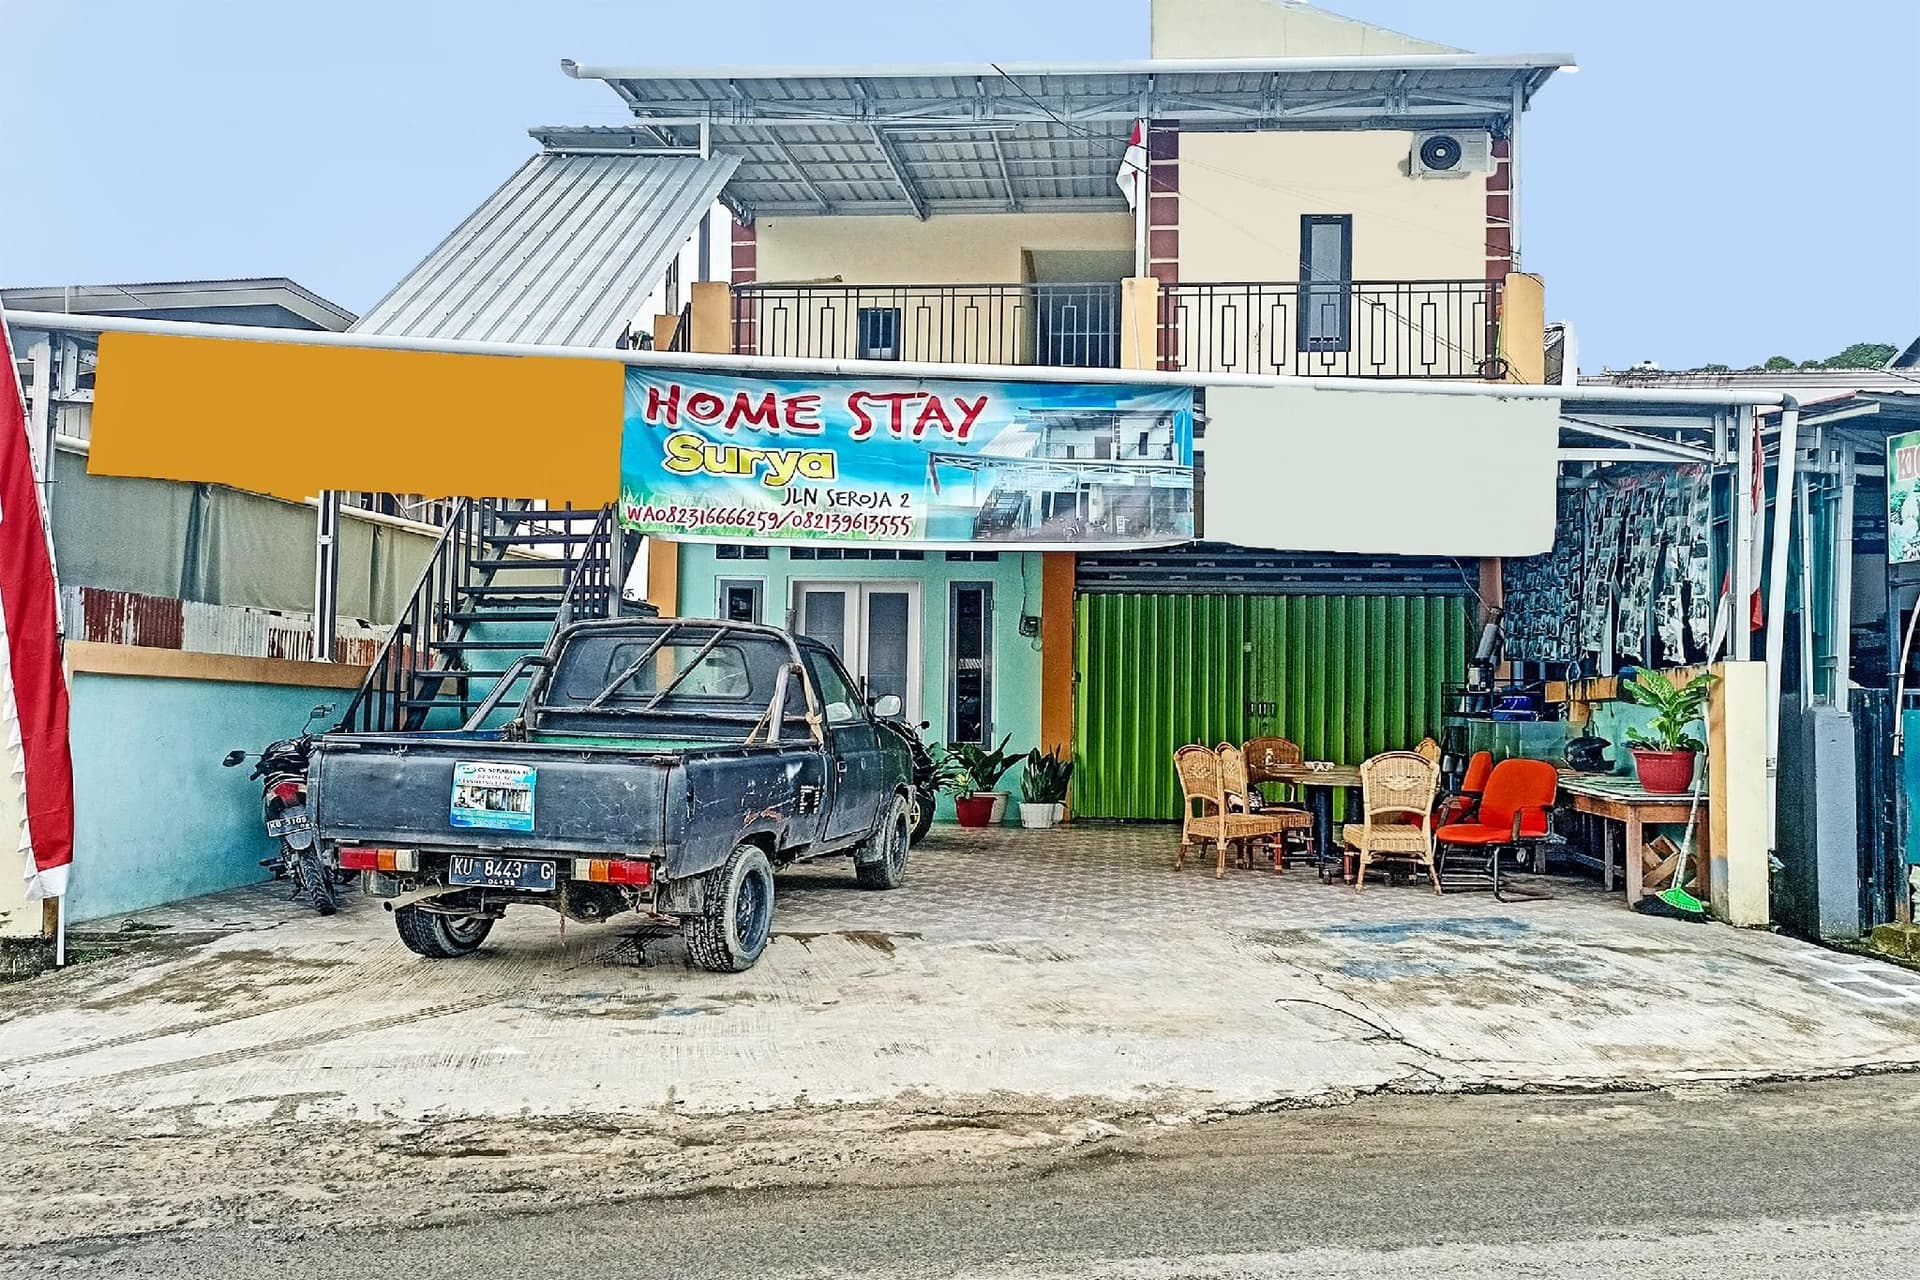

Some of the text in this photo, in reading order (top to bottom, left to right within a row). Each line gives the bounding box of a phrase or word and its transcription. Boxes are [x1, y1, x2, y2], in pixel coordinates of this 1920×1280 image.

[646, 384, 989, 438] HOME STAY
[666, 433, 835, 487] Surya
[782, 487, 911, 510] JLN SEROJA 2
[454, 857, 551, 880] KU 8443 G
